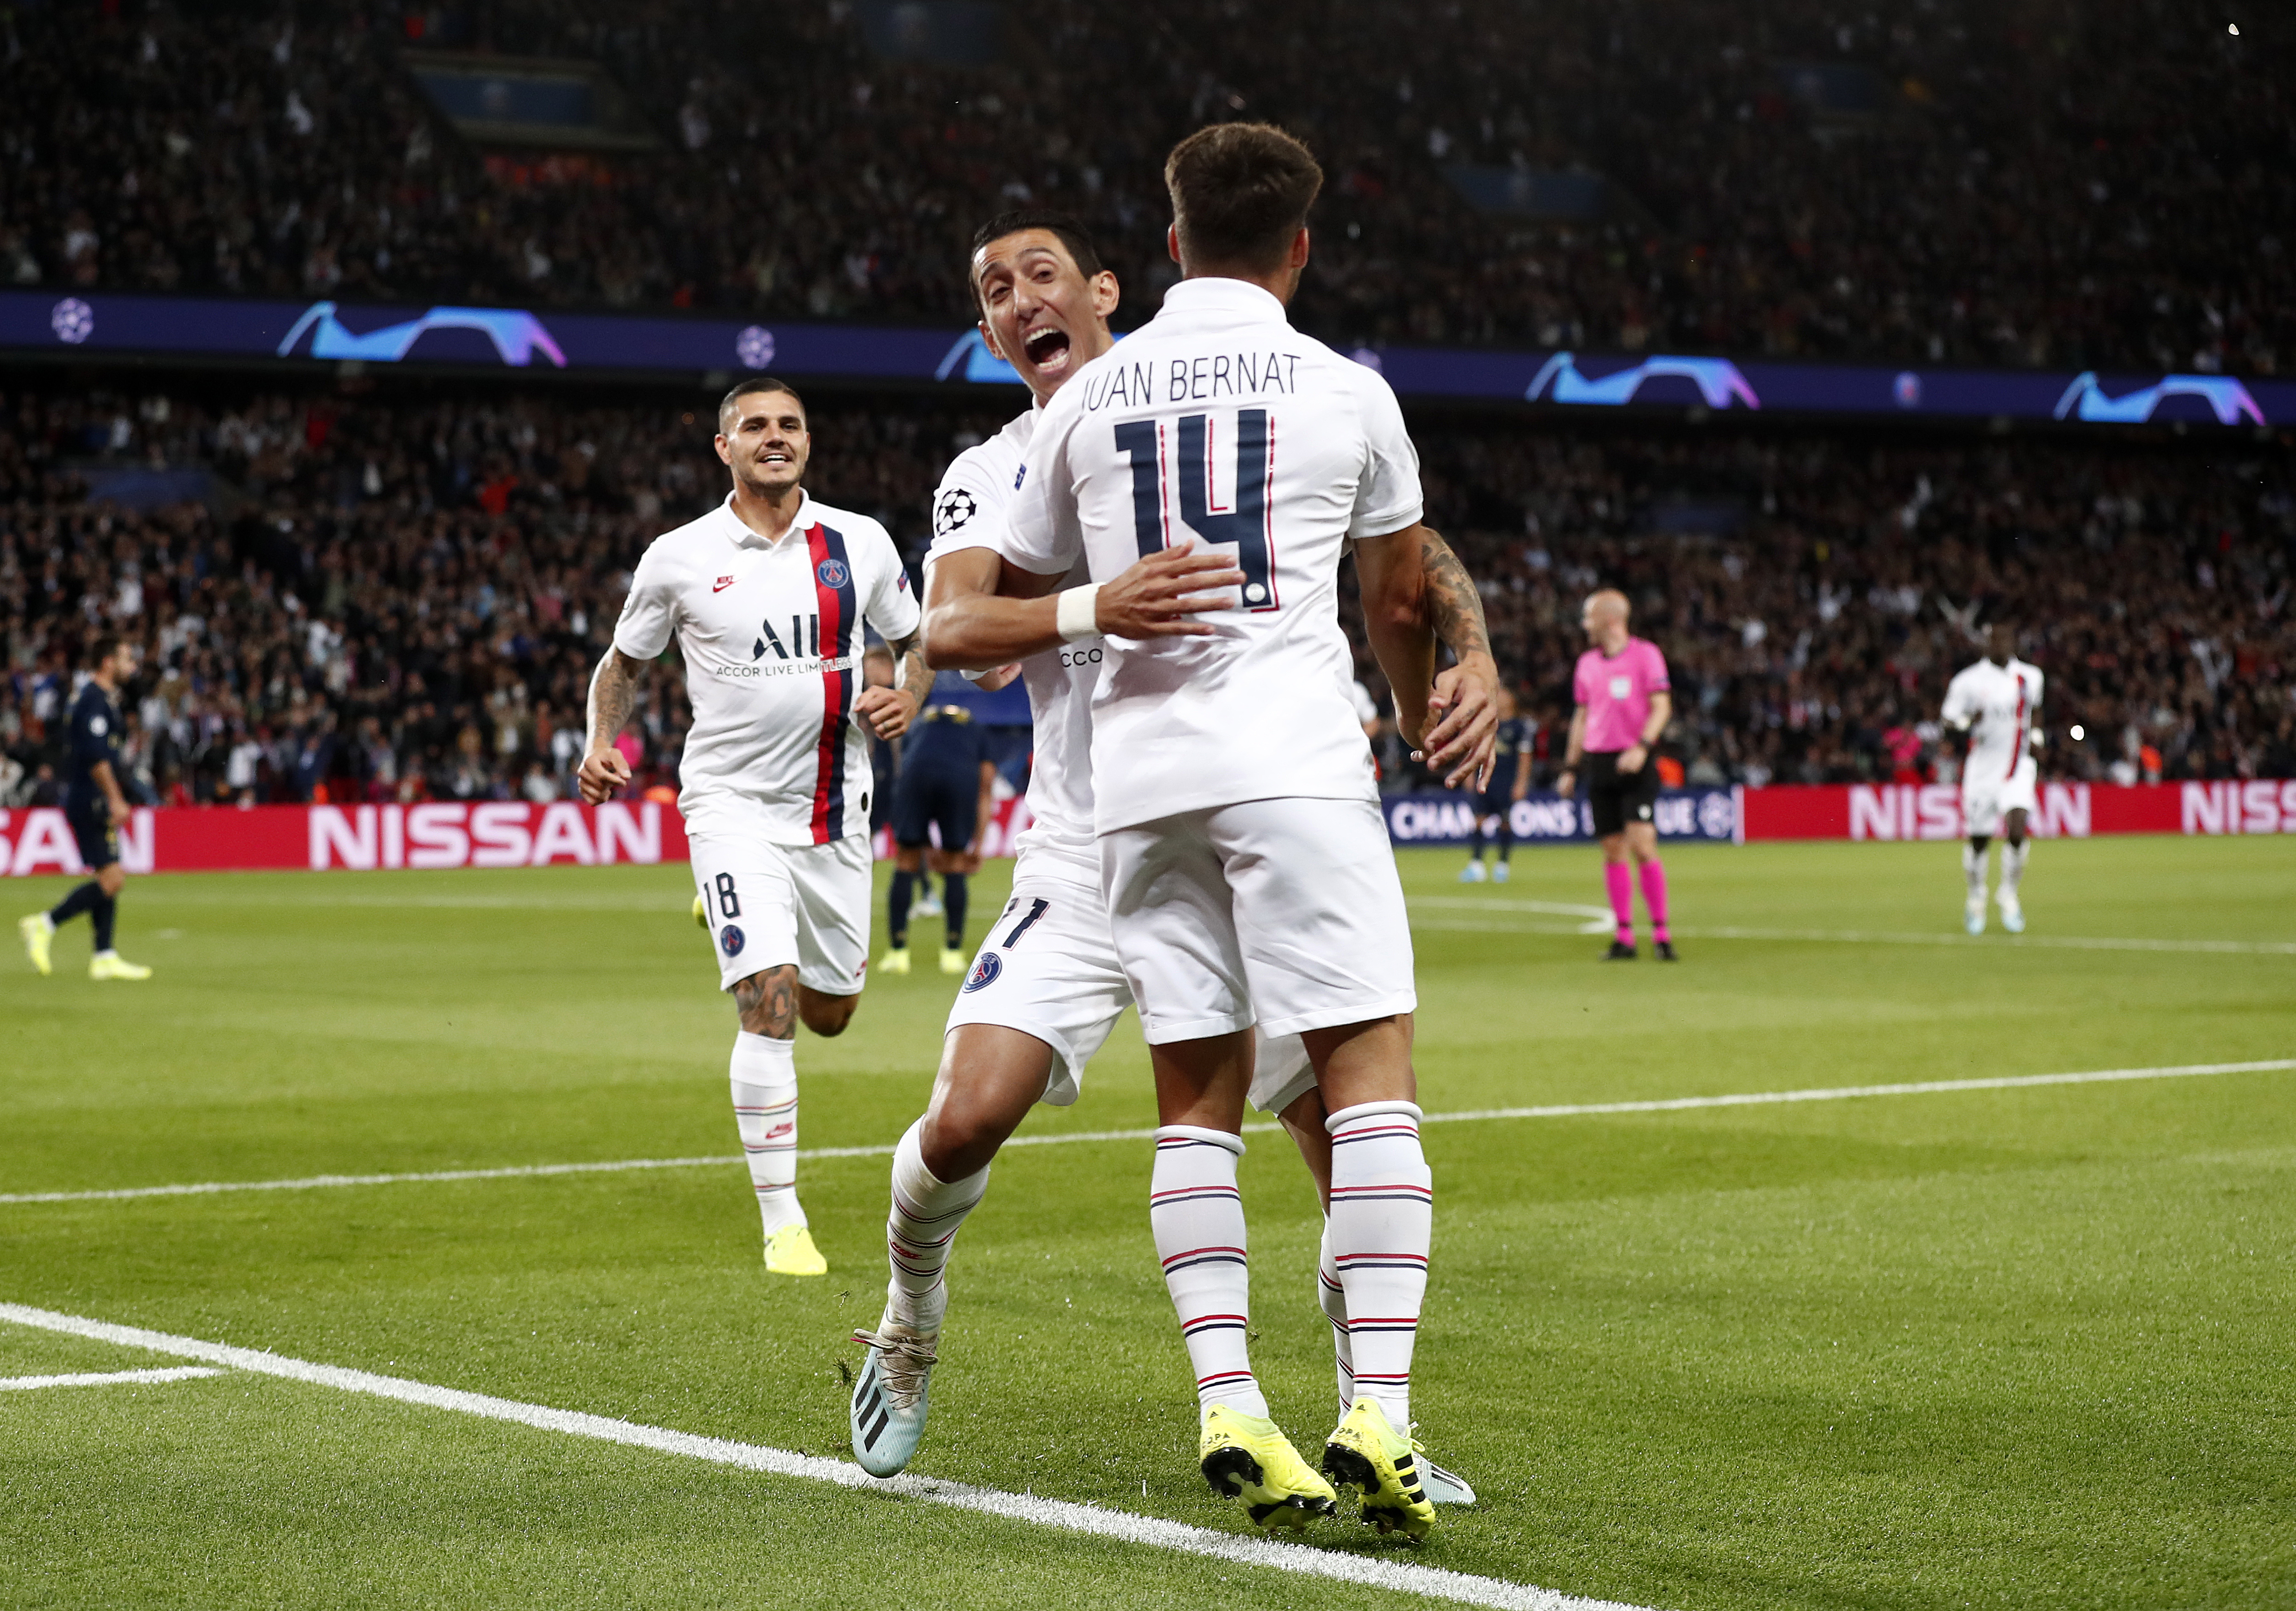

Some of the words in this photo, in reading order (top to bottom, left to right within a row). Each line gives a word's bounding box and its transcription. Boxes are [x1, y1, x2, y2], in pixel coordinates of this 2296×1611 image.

[1170, 352, 1301, 401] BERNAT
[1114, 409, 1279, 614] 14
[716, 666, 760, 677] ACCOR
[765, 664, 794, 676] LIVE
[798, 656, 853, 674] LIMITLESS
[310, 802, 661, 870] NISSAN
[704, 872, 741, 928] 18
